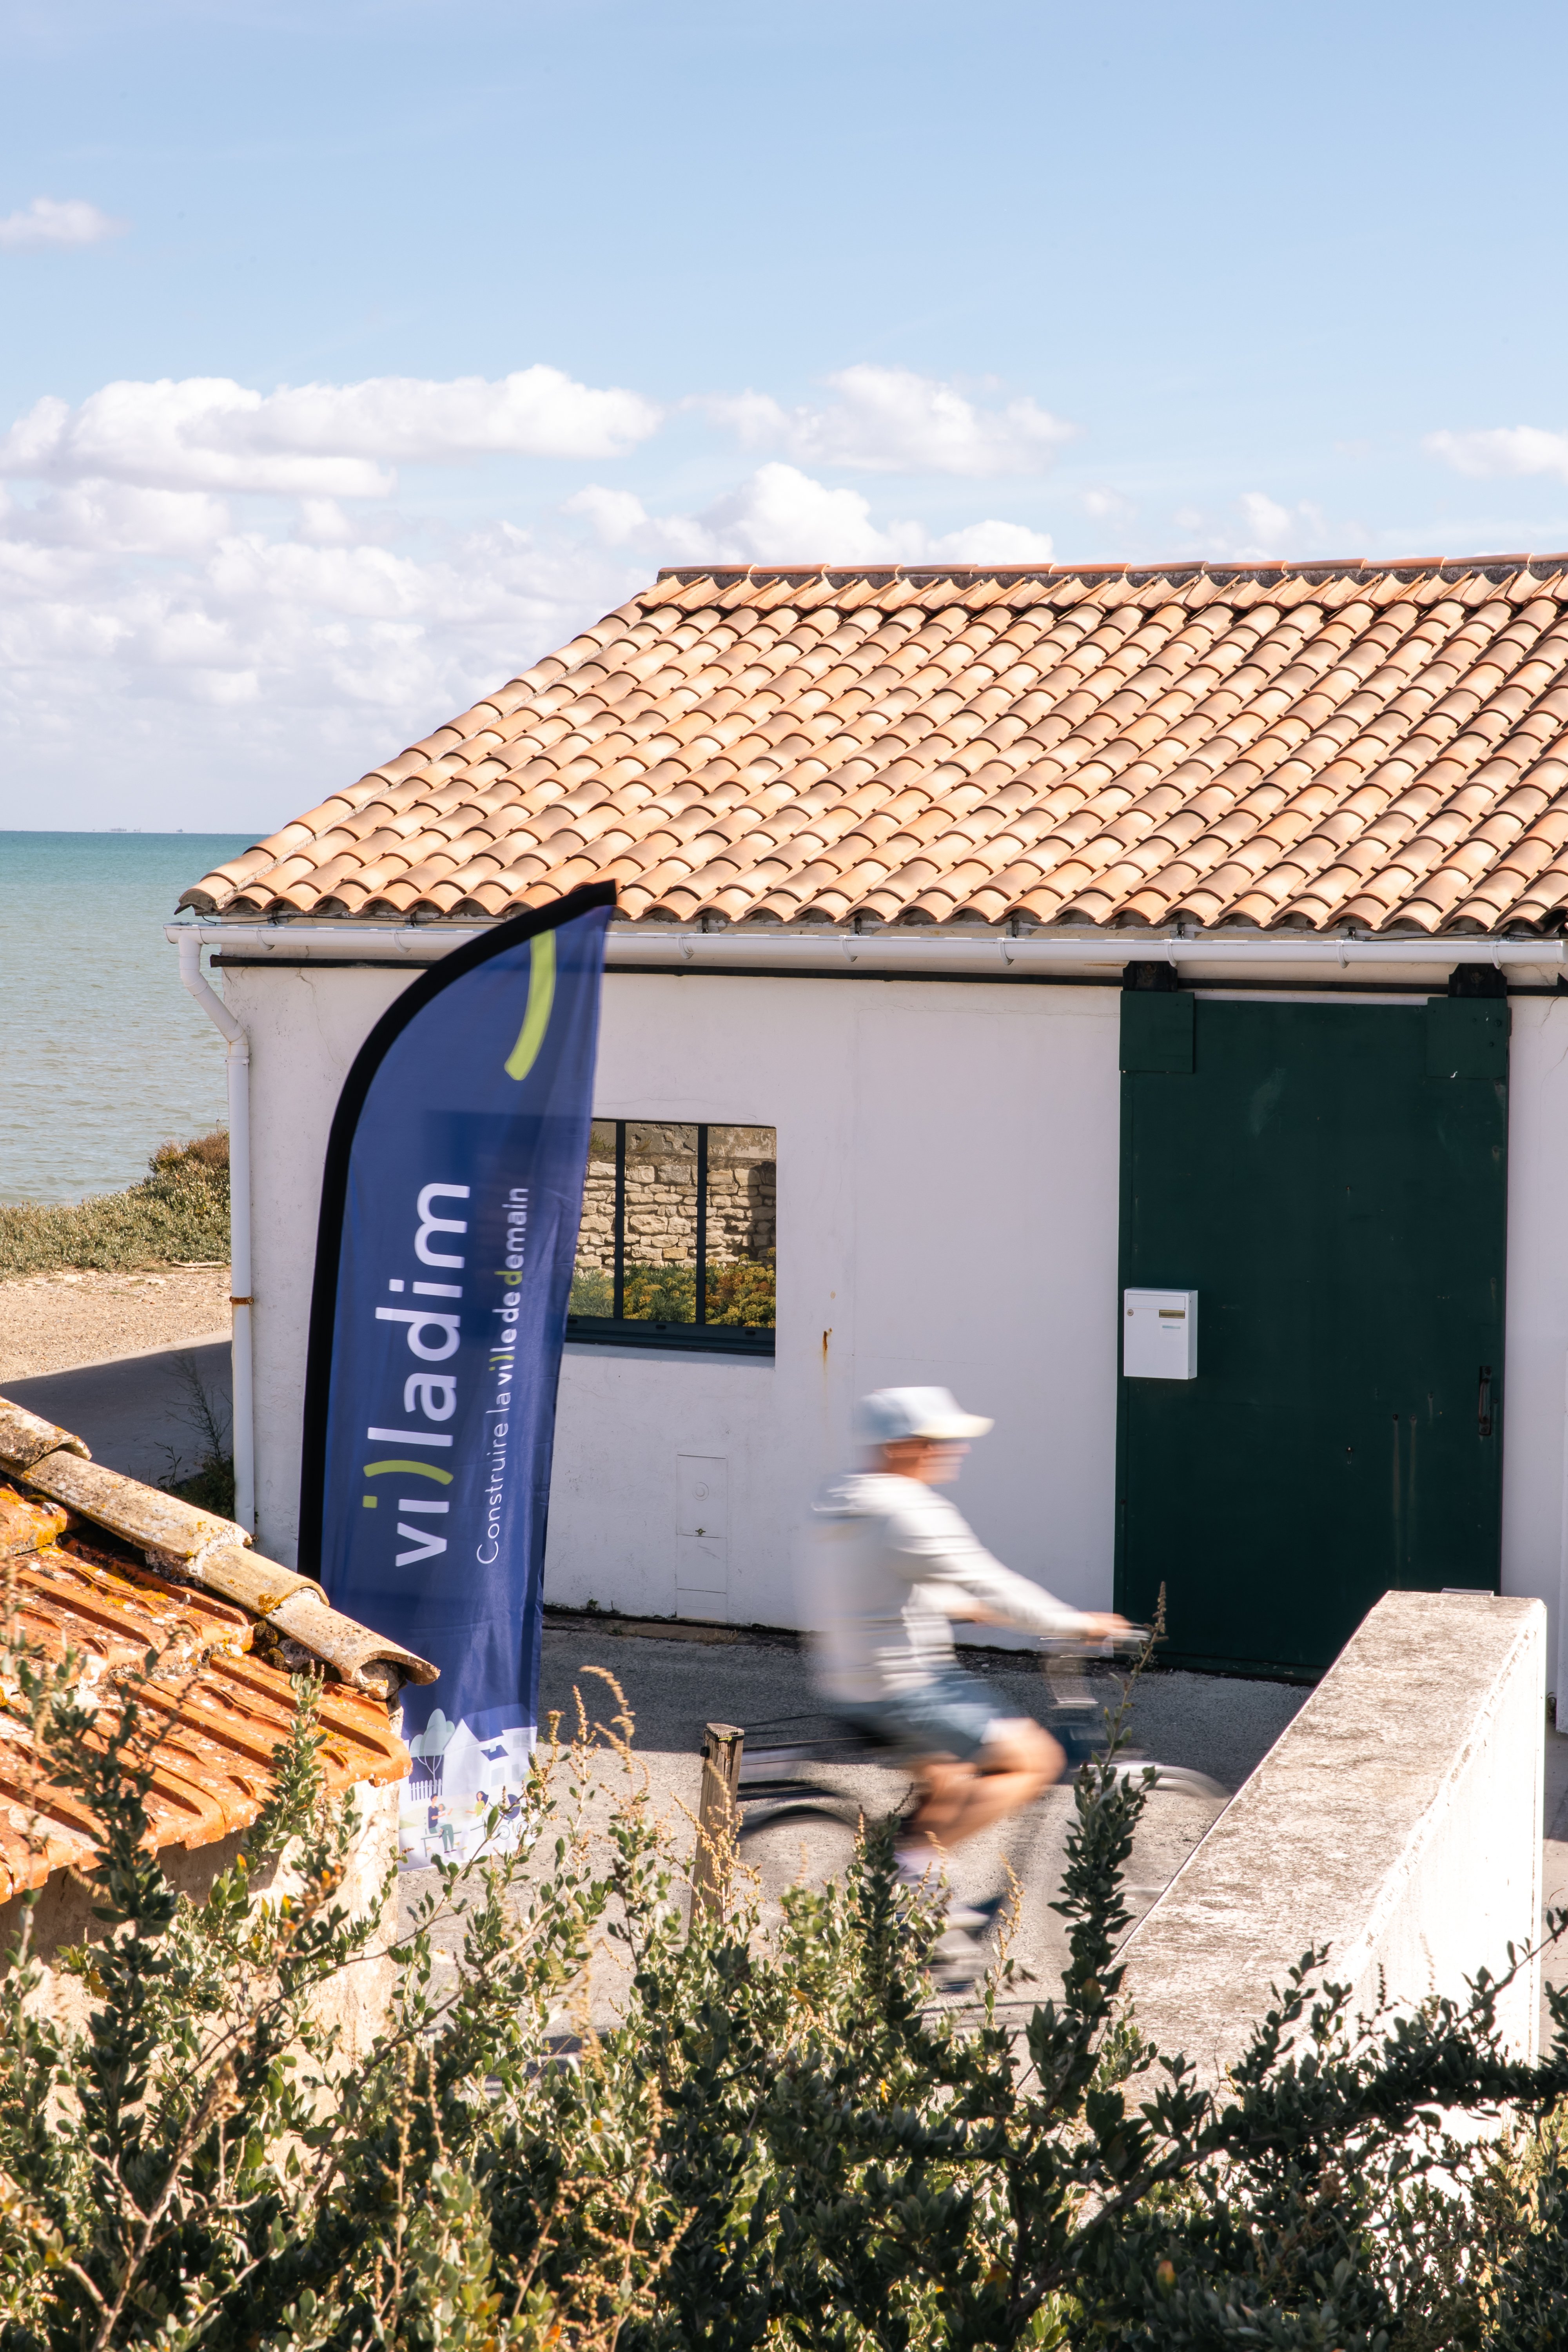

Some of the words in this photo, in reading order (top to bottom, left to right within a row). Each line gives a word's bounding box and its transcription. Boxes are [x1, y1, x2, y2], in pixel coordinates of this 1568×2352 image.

[494, 1188, 529, 1286] demain
[492, 1291, 521, 1323] de
[485, 1392, 511, 1414] la
[476, 1423, 508, 1564] Construire
